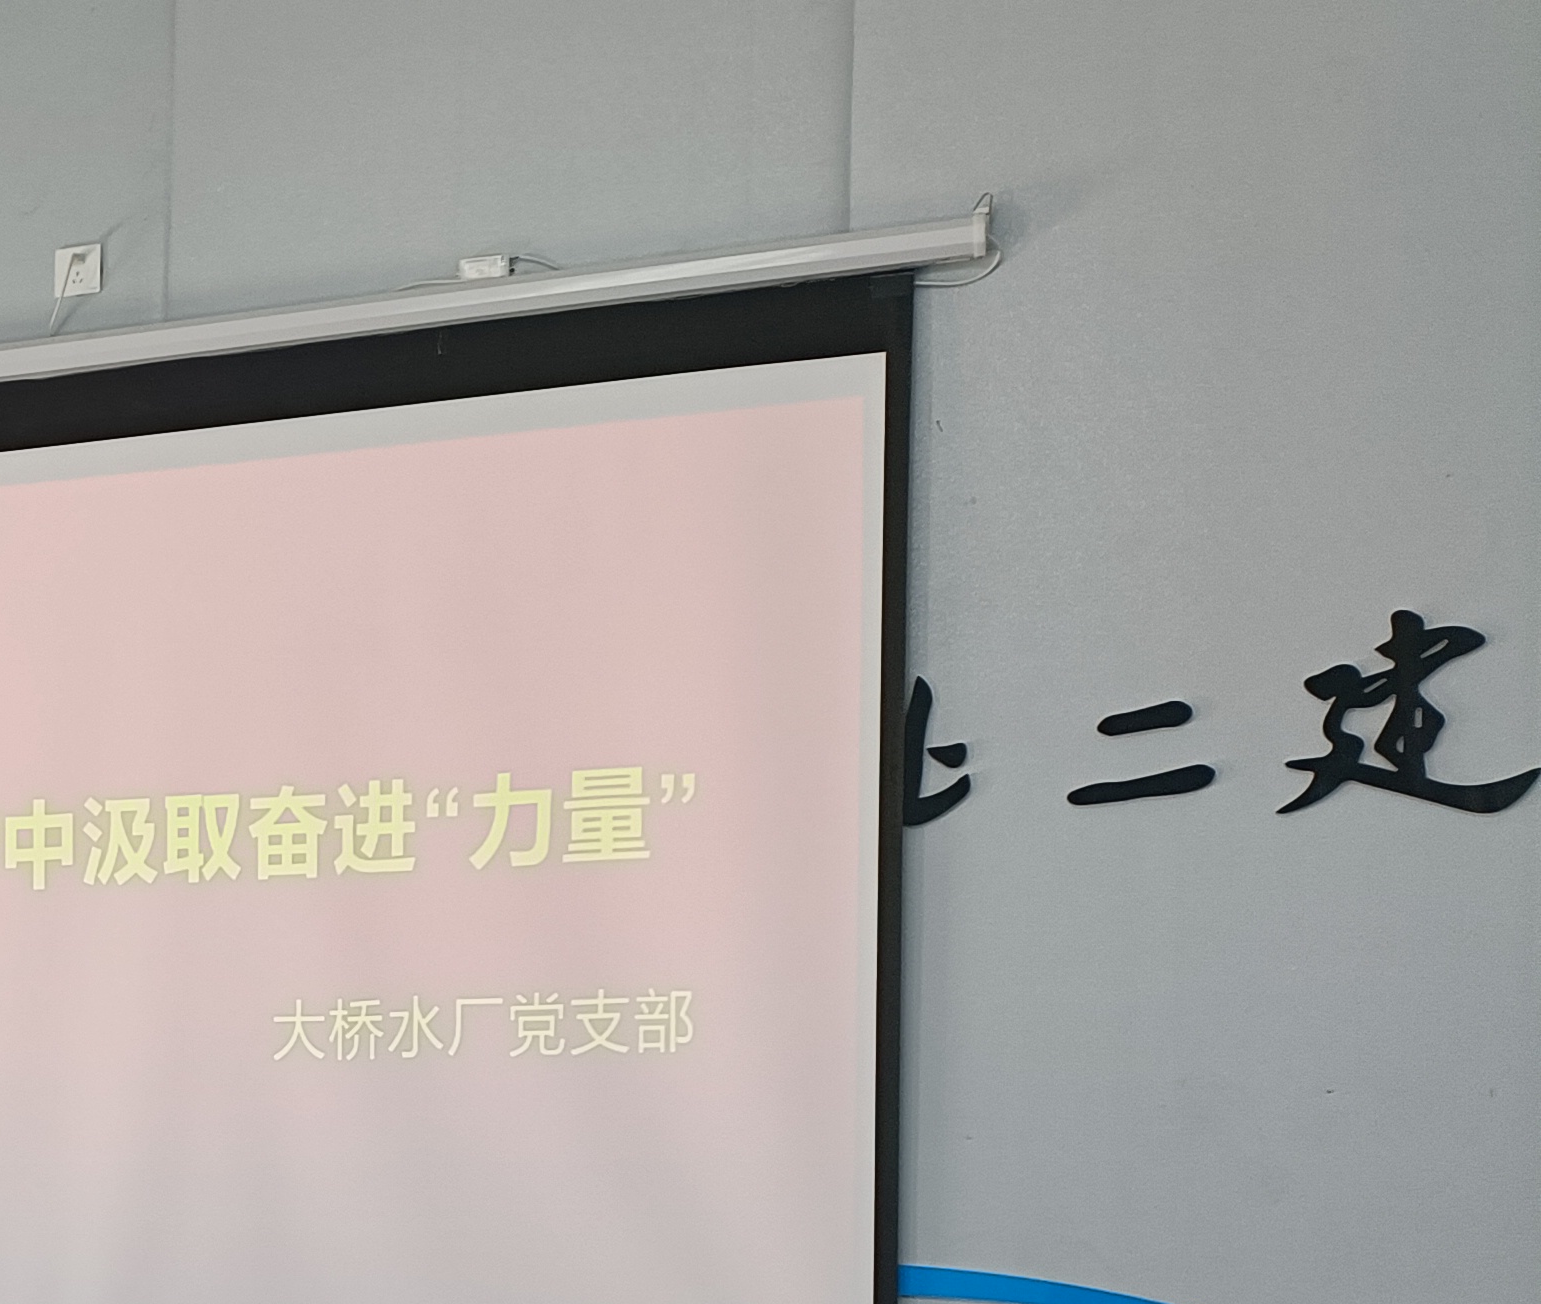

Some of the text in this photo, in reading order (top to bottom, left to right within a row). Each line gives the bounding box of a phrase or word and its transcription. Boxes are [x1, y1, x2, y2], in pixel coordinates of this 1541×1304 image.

[273, 988, 694, 1061] 大桥水厂党支部
